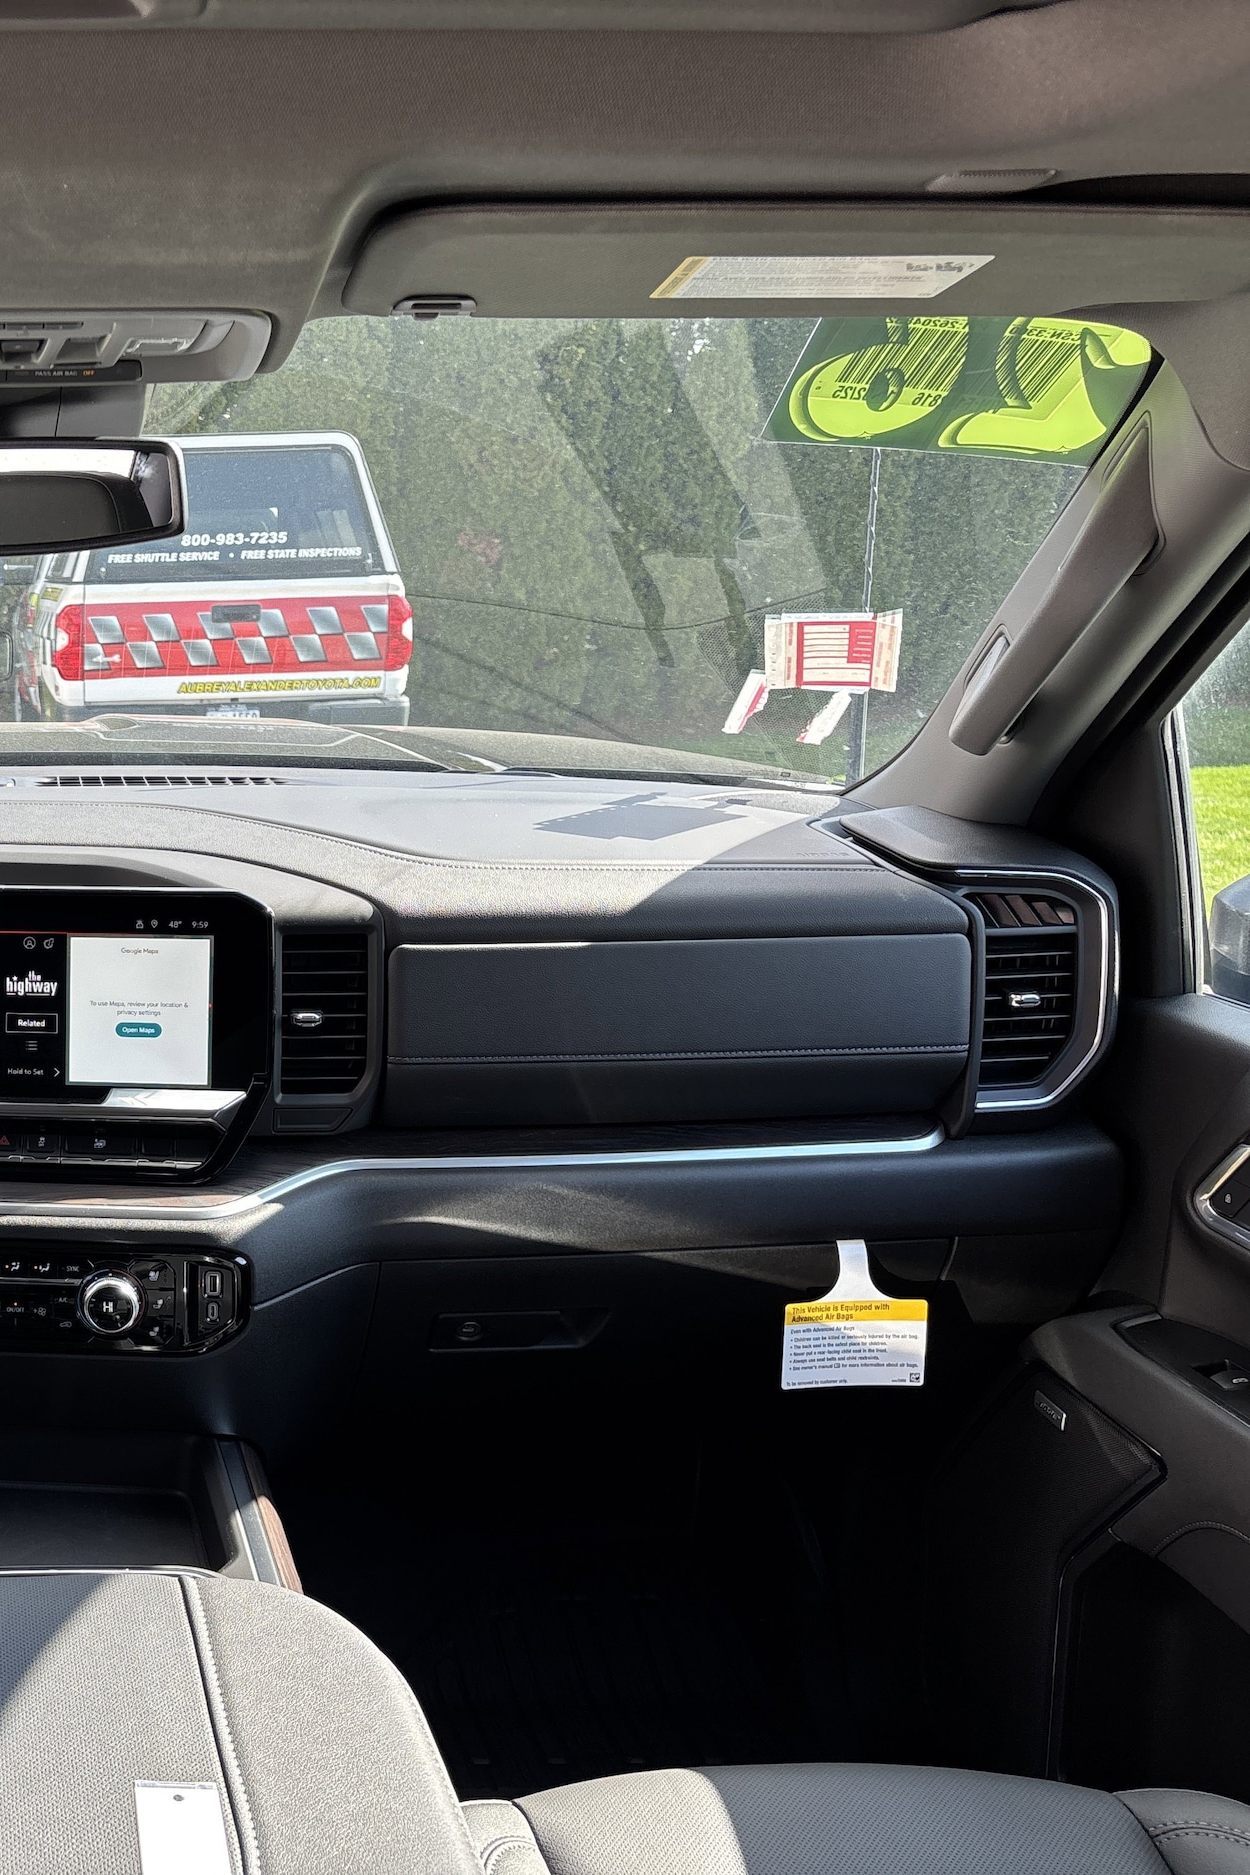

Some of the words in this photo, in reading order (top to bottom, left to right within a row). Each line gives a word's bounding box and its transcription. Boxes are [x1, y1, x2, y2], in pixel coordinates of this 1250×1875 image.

[181, 531, 288, 547] 800-983-7235
[108, 554, 134, 564] FREE
[134, 552, 178, 563] SHUTTLE
[178, 551, 221, 562] SERVICE
[240, 550, 266, 560] FREE
[266, 549, 298, 559] STATE
[298, 546, 362, 558] INSPECTIONS
[177, 676, 381, 694] AUBREYALEXANDERTOYOTA.COM
[168, 921, 182, 929] 48°
[192, 921, 209, 929] 9:59
[121, 947, 142, 955] Google
[28, 970, 42, 982] the
[6, 976, 58, 996] highway
[18, 1019, 46, 1027] Related
[33, 1068, 44, 1076] Set
[807, 1305, 831, 1313] Vehicle
[840, 1304, 872, 1312] Equipped
[791, 1314, 824, 1323] Advanced
[836, 1313, 854, 1321] Bags
